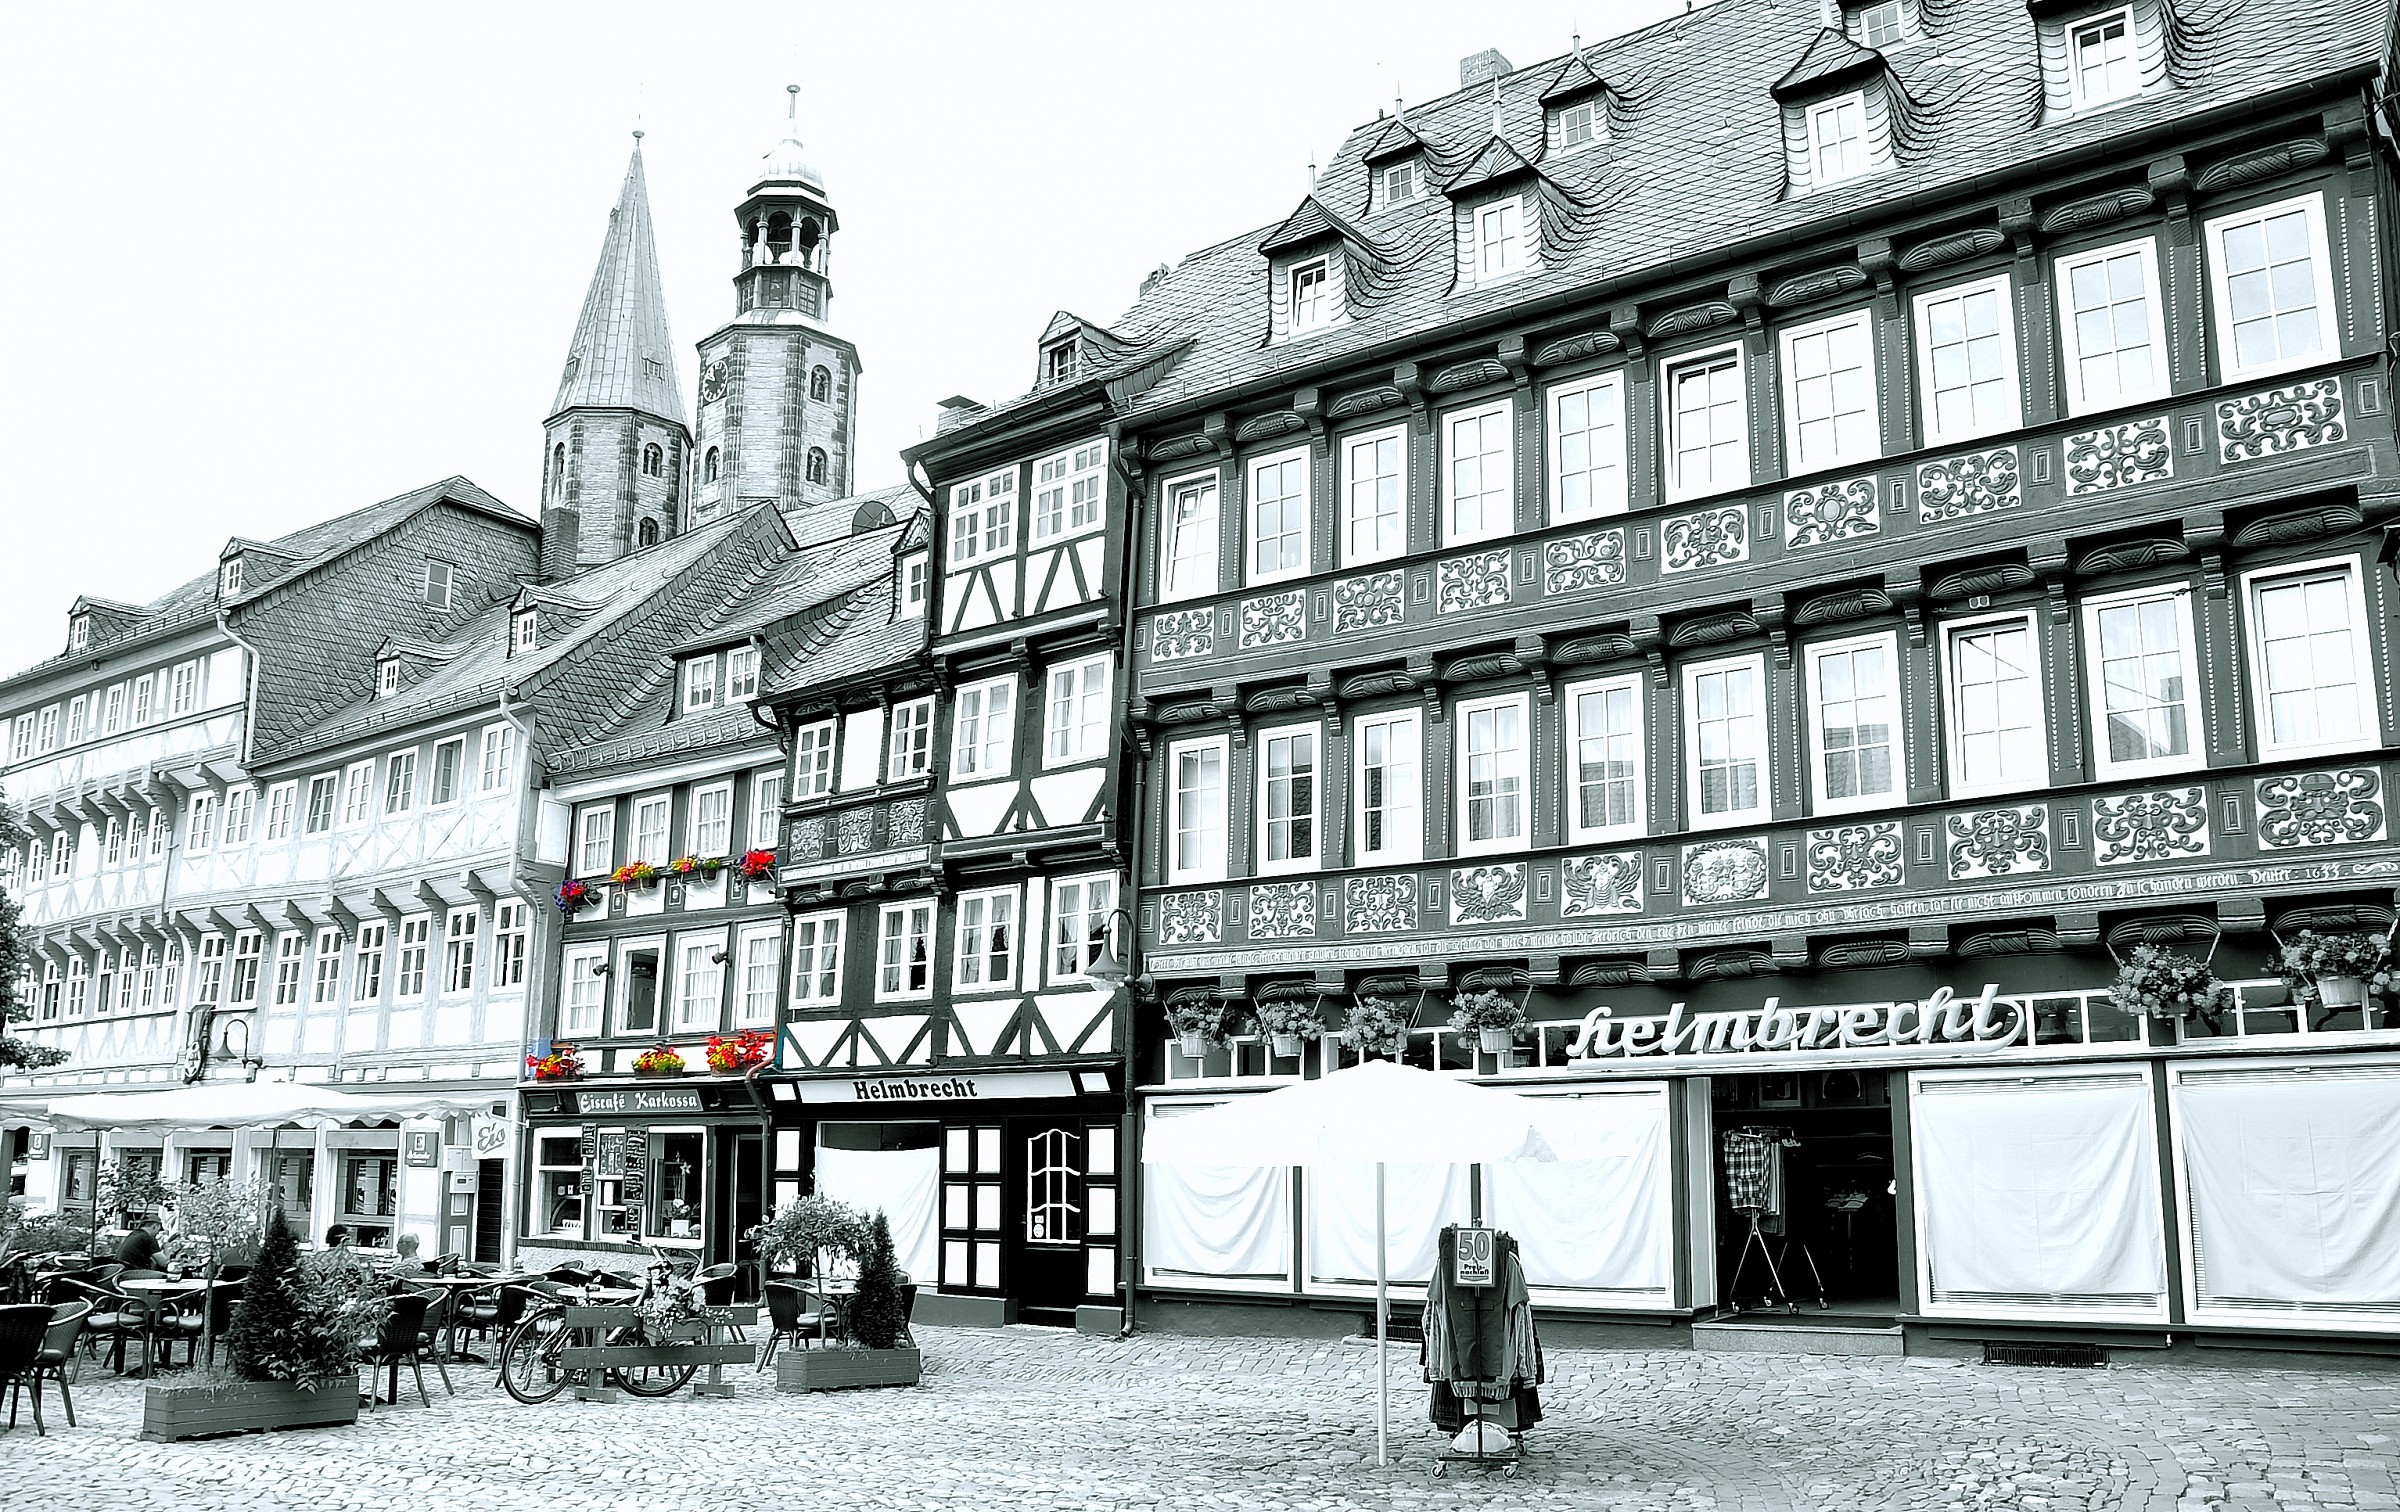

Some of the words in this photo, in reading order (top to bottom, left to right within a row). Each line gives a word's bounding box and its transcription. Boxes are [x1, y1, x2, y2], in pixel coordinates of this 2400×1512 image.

[580, 1092, 626, 1113] Eiscafé
[634, 1091, 698, 1110] Karkossa
[852, 1078, 978, 1100] Helmbrecht
[477, 1122, 506, 1152] Eis
[1459, 1231, 1490, 1261] 50
